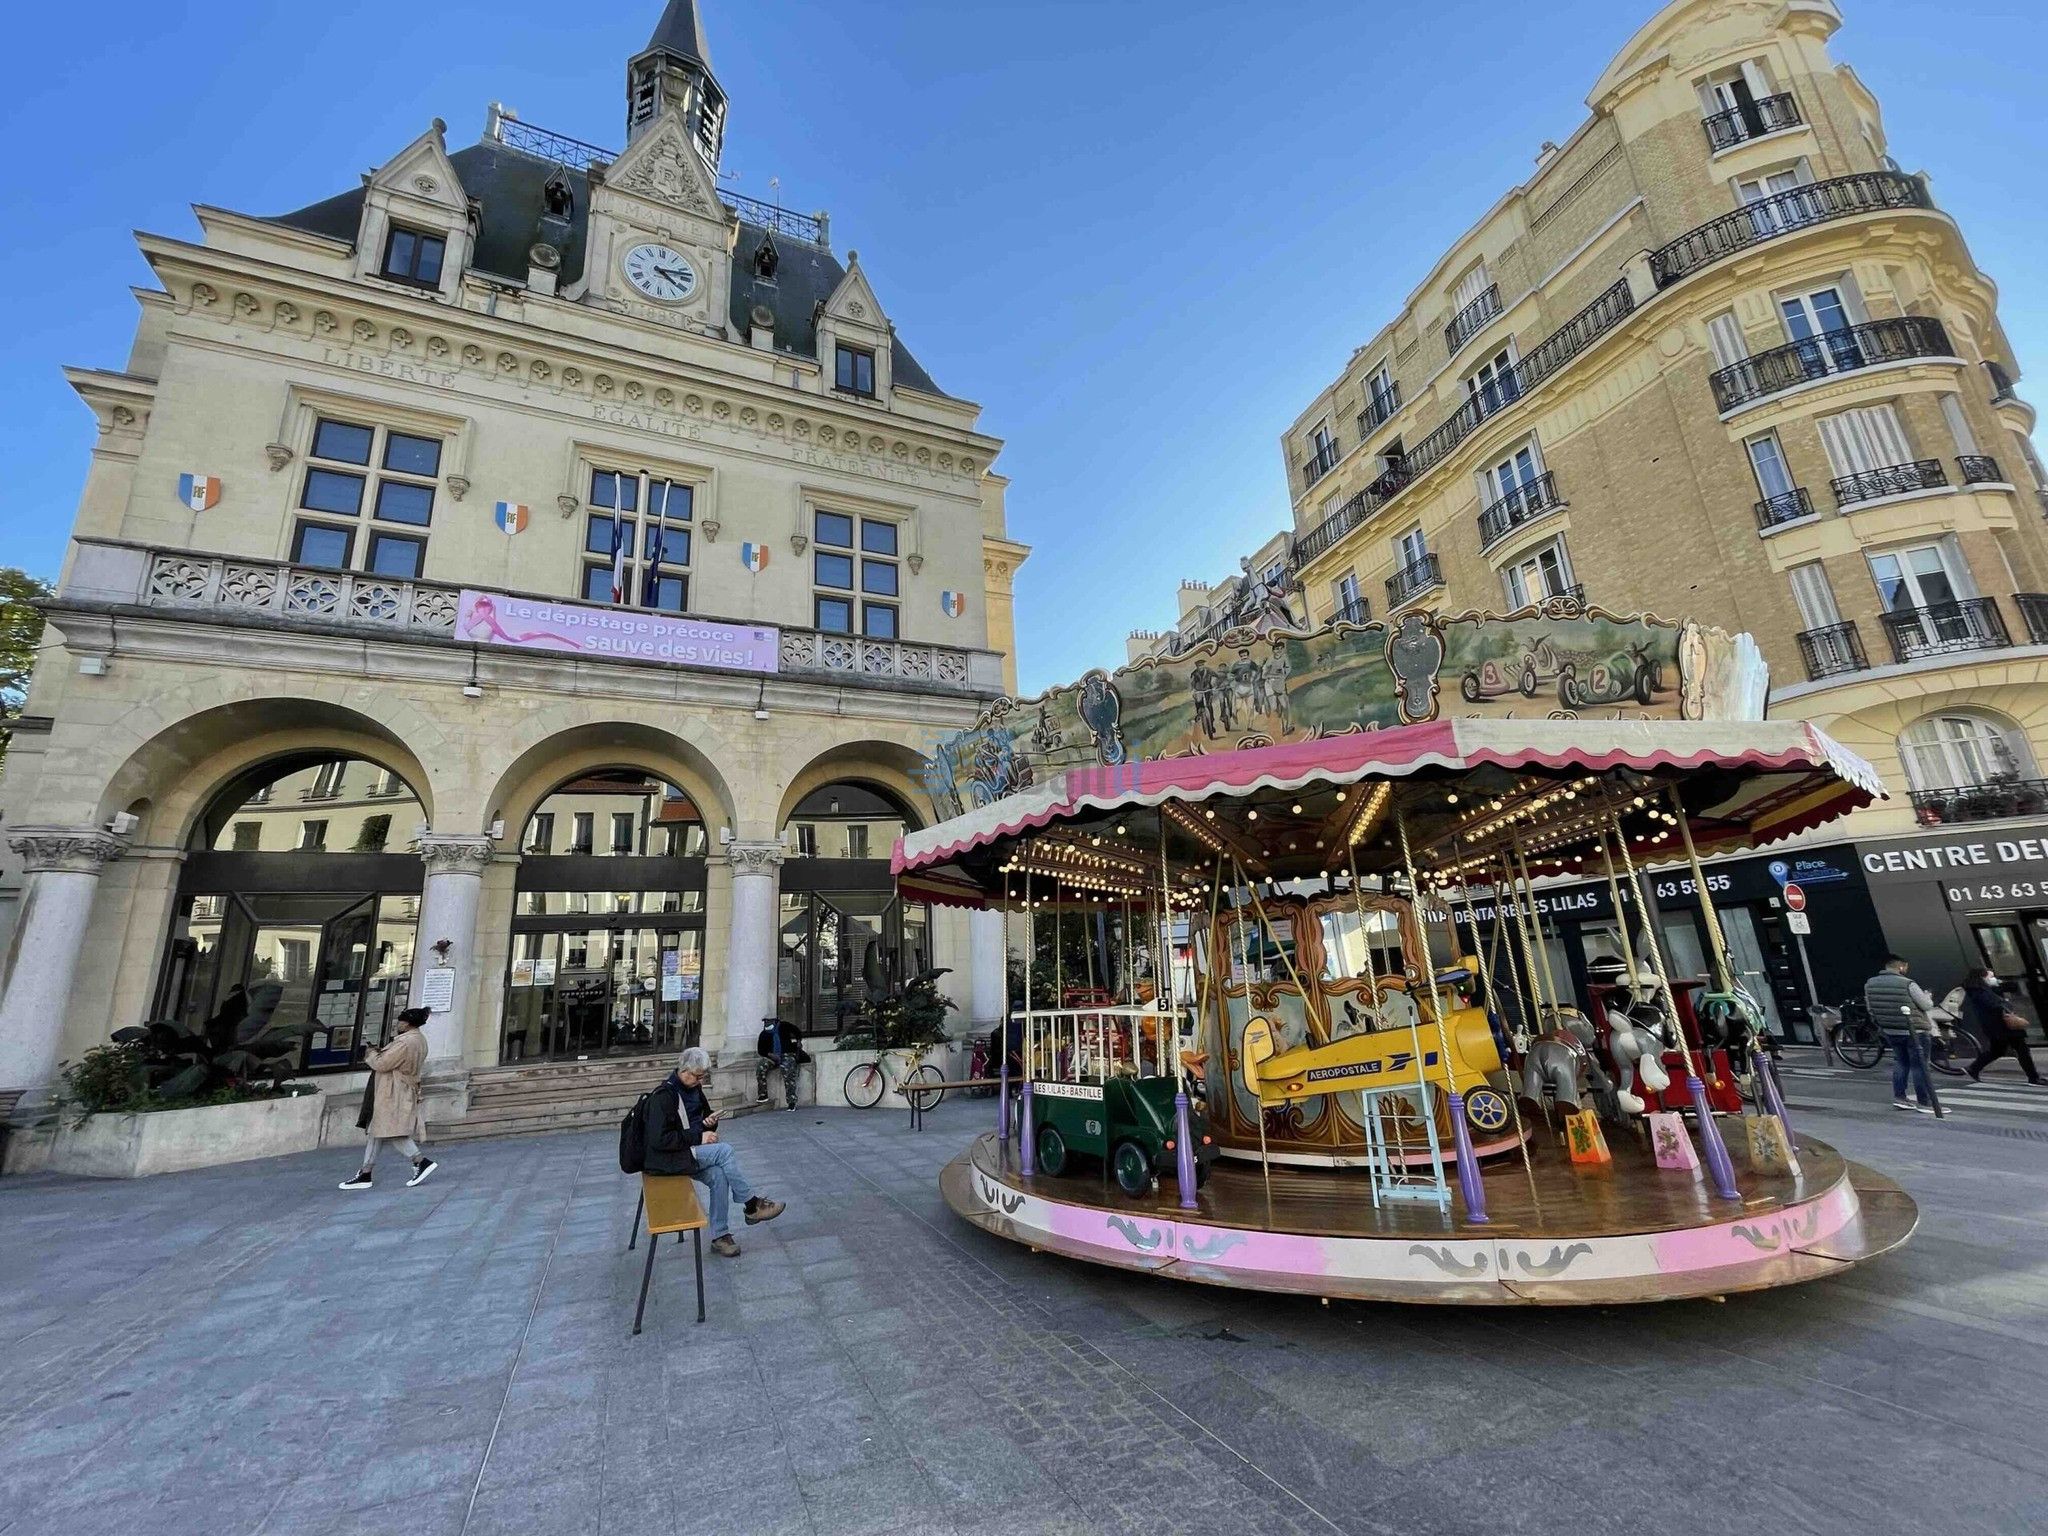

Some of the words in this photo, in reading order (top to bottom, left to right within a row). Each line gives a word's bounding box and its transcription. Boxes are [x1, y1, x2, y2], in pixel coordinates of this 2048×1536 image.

[625, 202, 702, 234] MAIRIE
[505, 603, 531, 619] Le
[537, 607, 649, 635] dépistage
[652, 622, 735, 643] précoce
[584, 634, 654, 654] sauve
[659, 640, 698, 661] des
[1594, 670, 1606, 690] 2
[1795, 859, 1827, 871] Place
[1863, 844, 1990, 873] CENTRE
[1551, 892, 1598, 912] LILAS
[1656, 883, 1677, 898] 63
[1709, 874, 1731, 891] 55
[1949, 887, 1973, 902] 01
[1980, 884, 2005, 900] 43
[2011, 882, 2036, 898] 63
[1160, 1000, 1167, 1010] 5
[1309, 1062, 1379, 1080] AEROPOSTALE
[1034, 1083, 1046, 1093] LES
